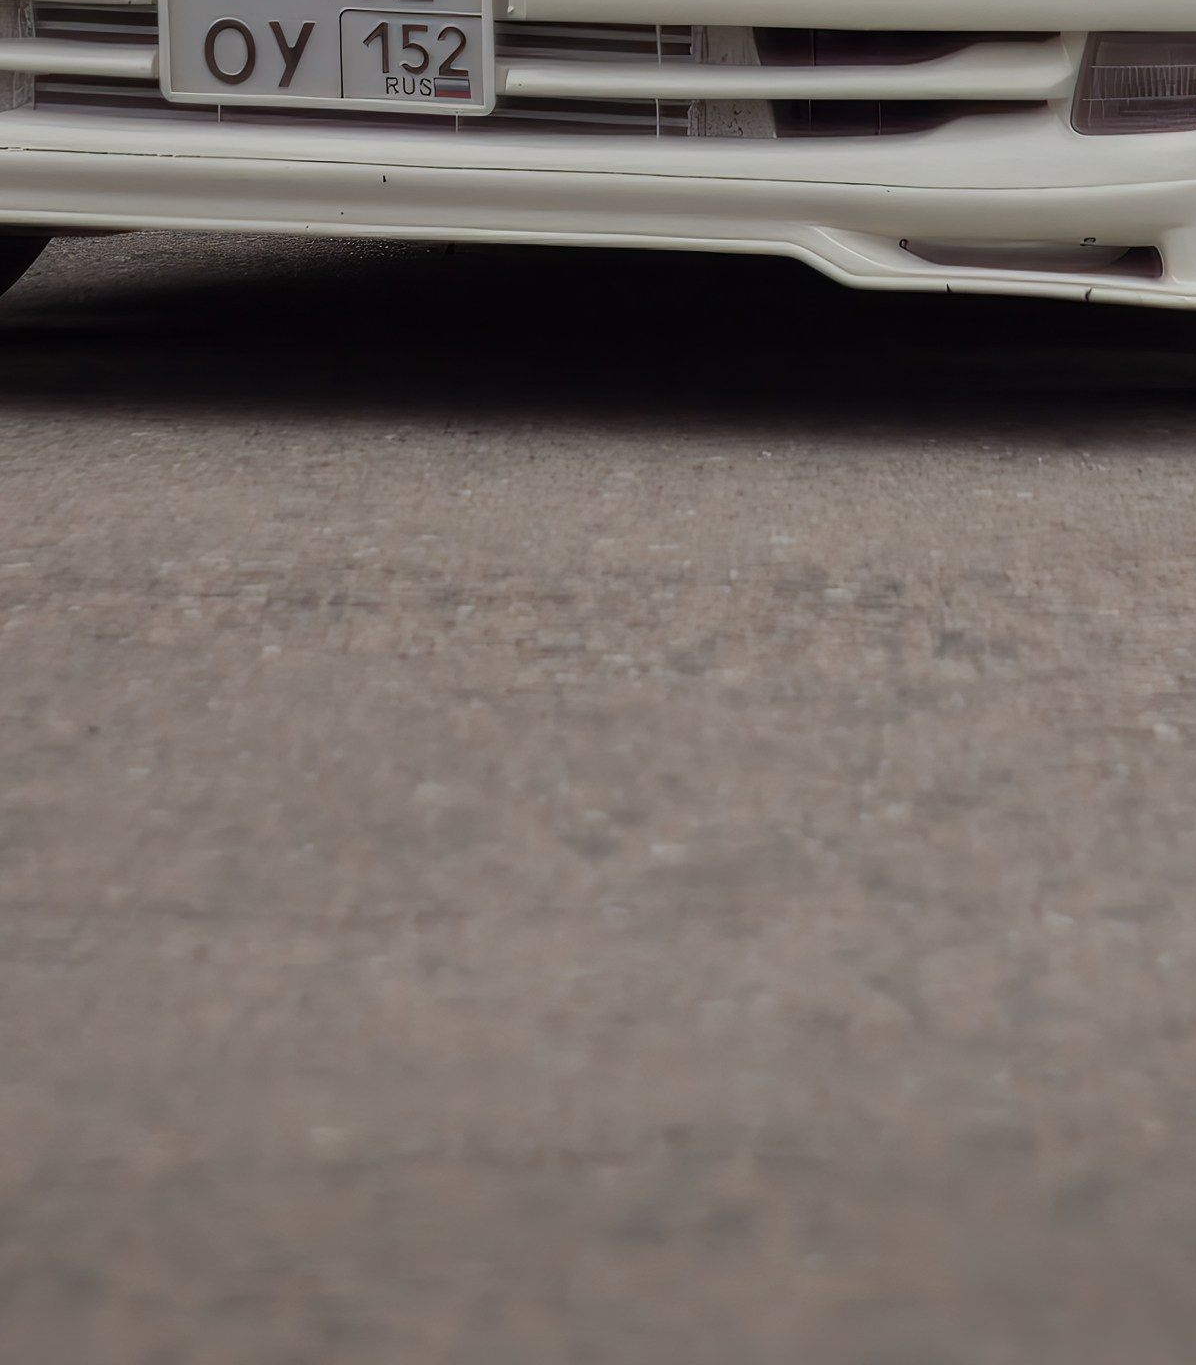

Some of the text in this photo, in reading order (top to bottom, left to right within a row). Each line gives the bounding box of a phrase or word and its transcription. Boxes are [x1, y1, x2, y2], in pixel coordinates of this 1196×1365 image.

[204, 18, 469, 88] ОУ 152
[385, 76, 432, 97] RUS
